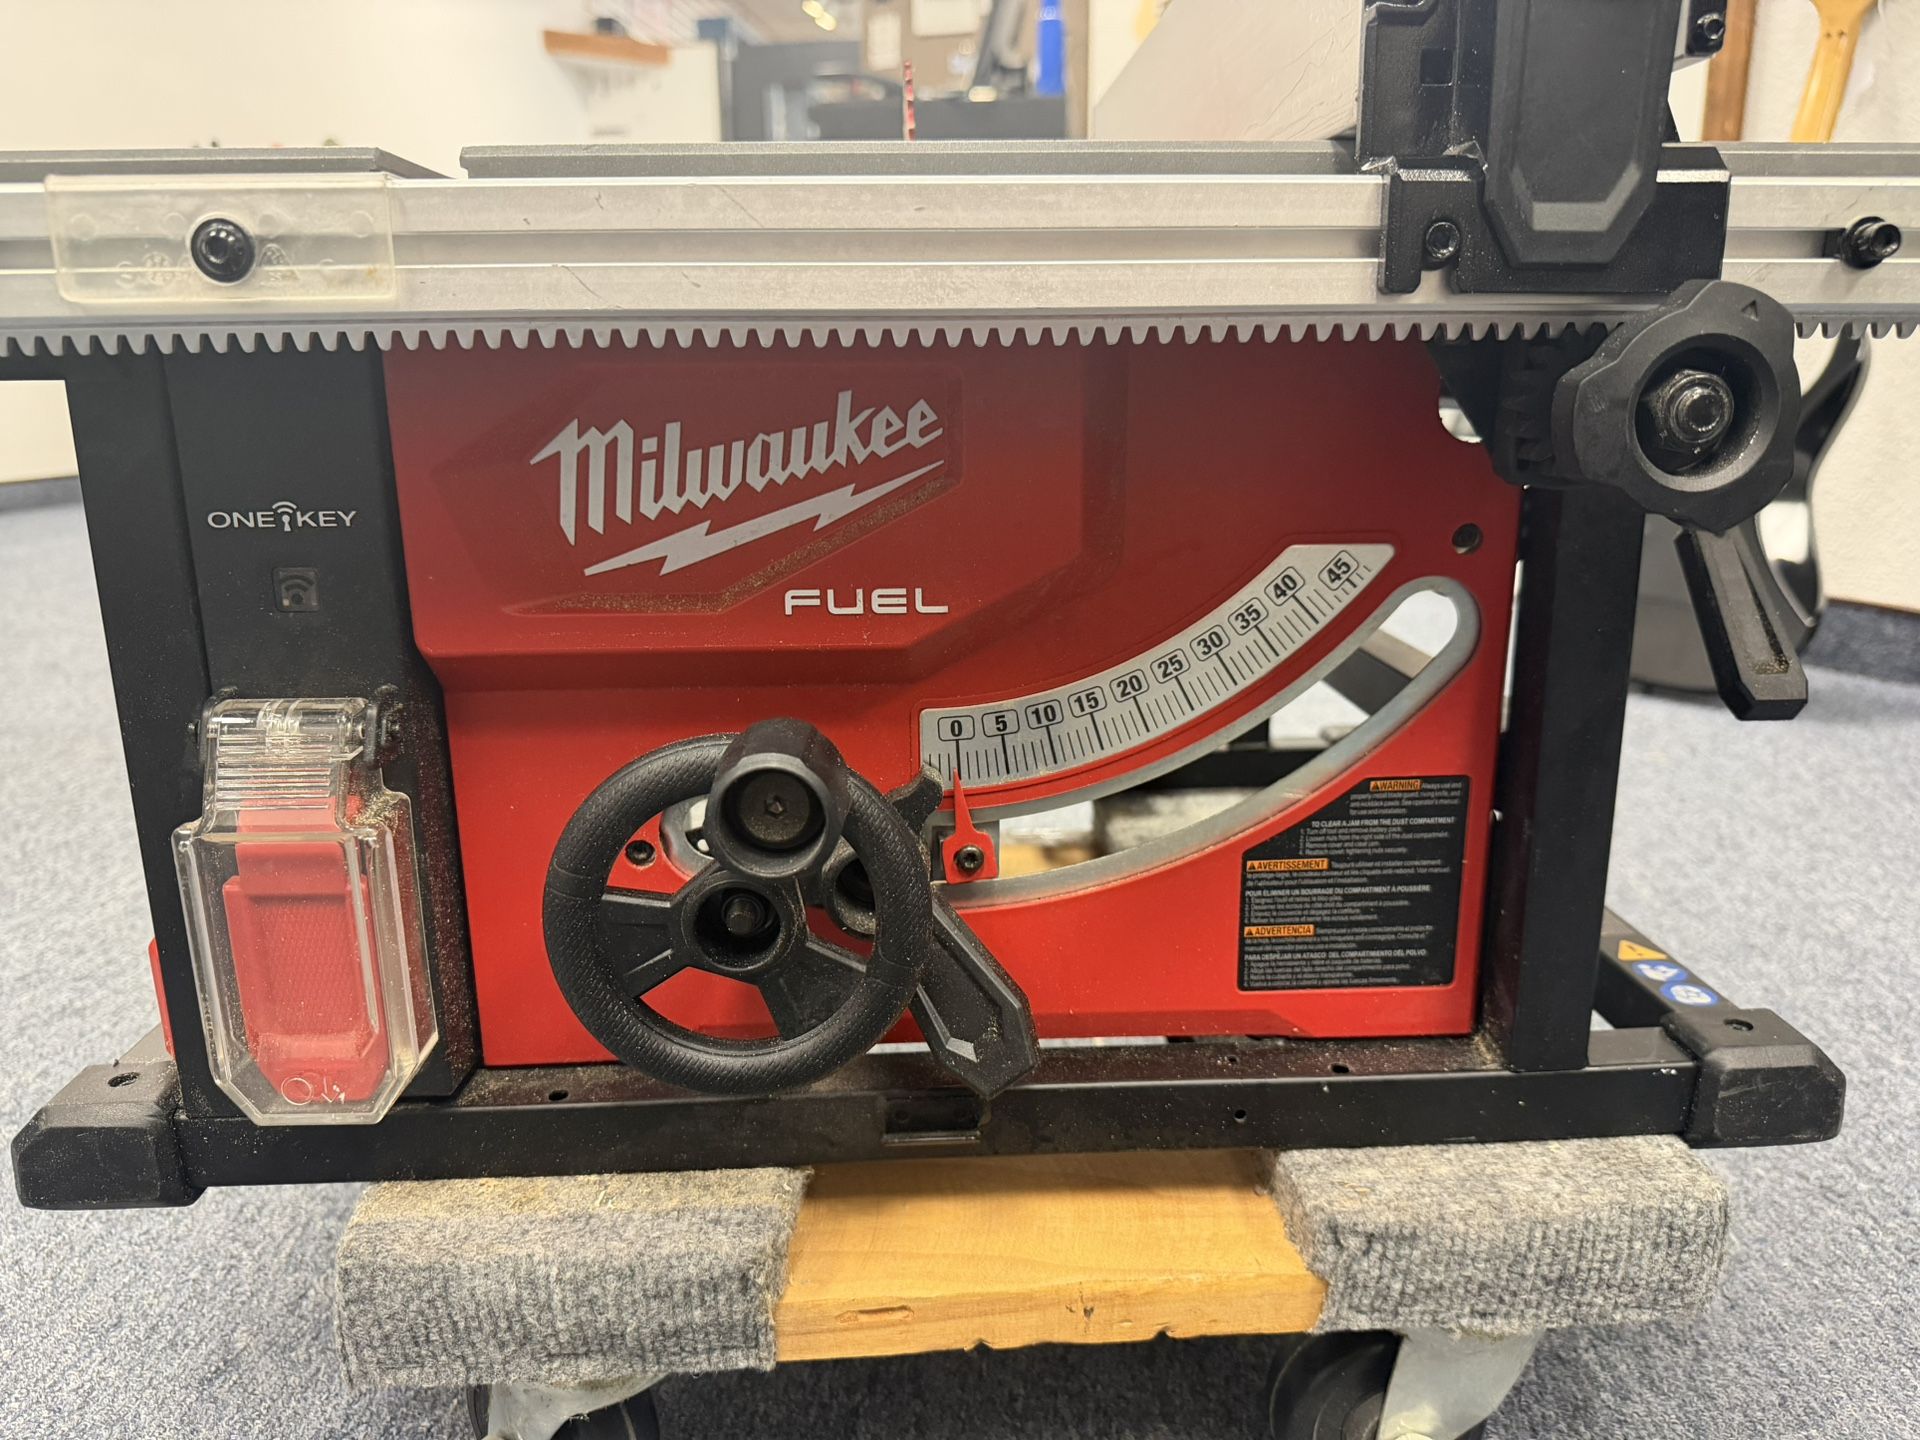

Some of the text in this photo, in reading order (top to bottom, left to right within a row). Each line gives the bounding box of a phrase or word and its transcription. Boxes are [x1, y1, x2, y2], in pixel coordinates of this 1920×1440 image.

[530, 390, 944, 546] Milwaukee
[207, 511, 357, 528] ONE KEY
[785, 588, 949, 616] FUEL
[951, 557, 1353, 737] 0 5 10 15 20 25 30 35 40 45
[1382, 780, 1420, 791] WARNING
[1409, 817, 1455, 825] COMPARTMENT
[1257, 860, 1325, 870] AVERTISSEMENT
[1255, 926, 1311, 935] ADVERTENCIA
